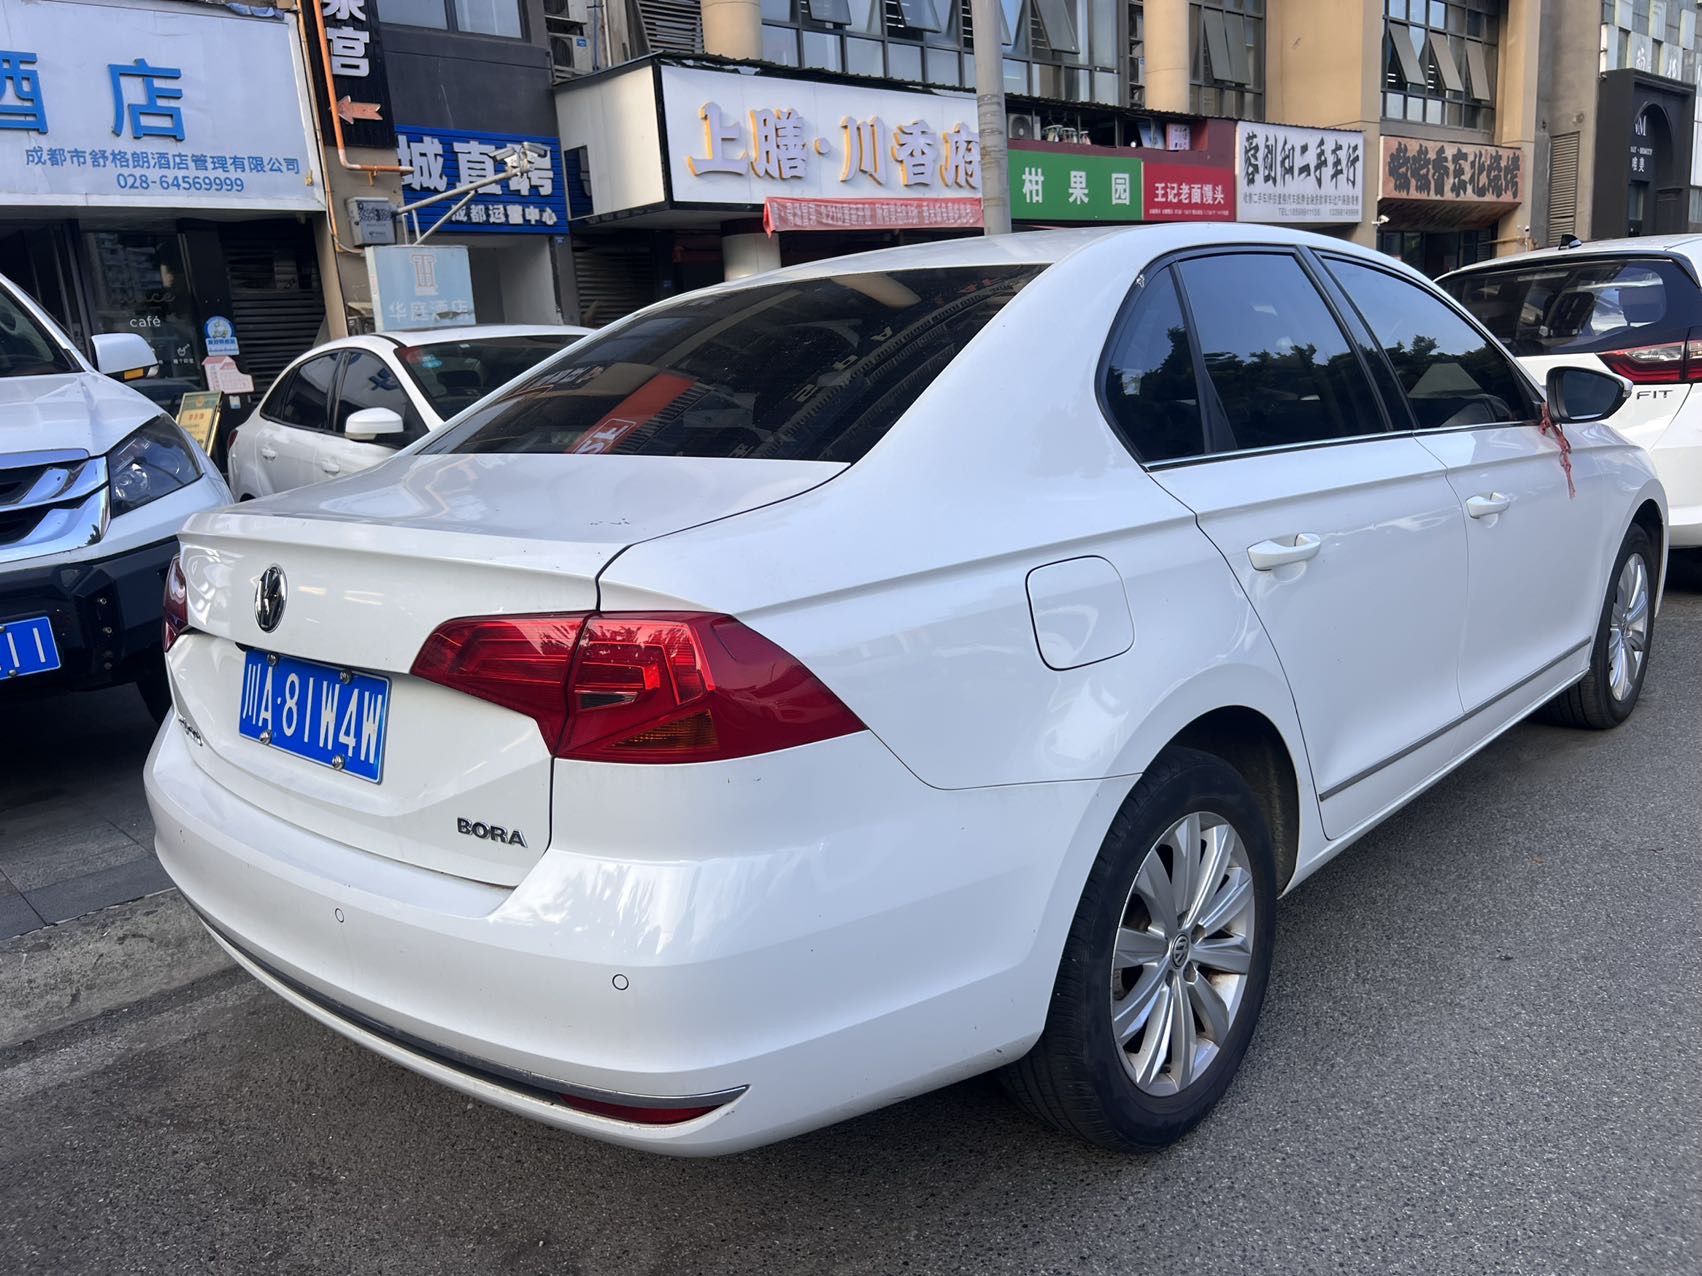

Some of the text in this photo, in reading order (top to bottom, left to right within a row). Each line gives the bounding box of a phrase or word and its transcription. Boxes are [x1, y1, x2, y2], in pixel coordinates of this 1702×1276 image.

[25, 146, 300, 175] 成都市舒格朗酒店管理有限公司
[397, 135, 554, 196] 城直聘
[116, 172, 244, 193] 028-64569999
[1022, 167, 1131, 206] 柑果园
[1154, 182, 1225, 205] 王记老面馒头
[451, 203, 558, 225] 成都运营中心
[129, 315, 162, 328] café
[1636, 389, 1674, 400] FIT
[242, 663, 383, 765] 川A·81W4W
[456, 816, 529, 849] BORA
